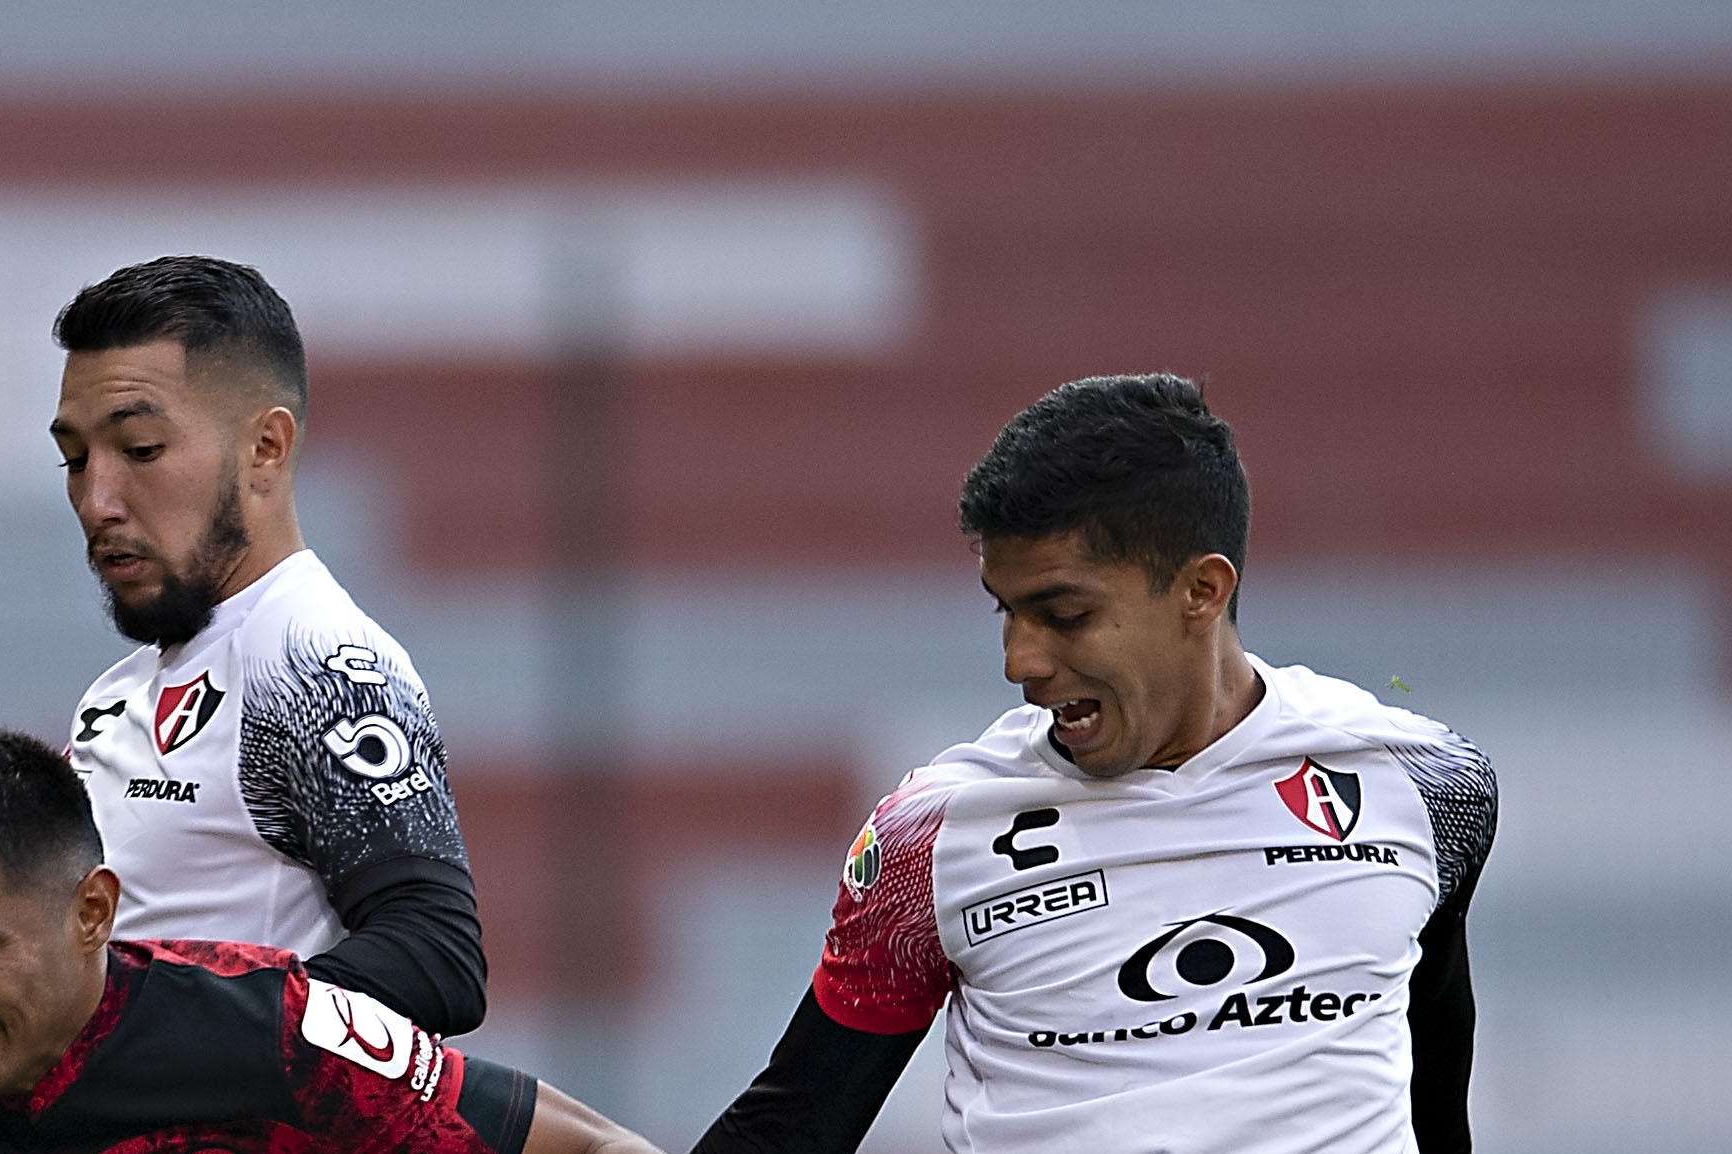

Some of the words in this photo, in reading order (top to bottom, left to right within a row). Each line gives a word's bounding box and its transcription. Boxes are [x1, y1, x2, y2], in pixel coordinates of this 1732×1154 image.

[124, 779, 199, 803] PERDURA
[371, 765, 433, 805] Berel
[1264, 844, 1400, 866] PERDURA
[971, 881, 1097, 935] URREA
[1207, 985, 1382, 1031] Aztec
